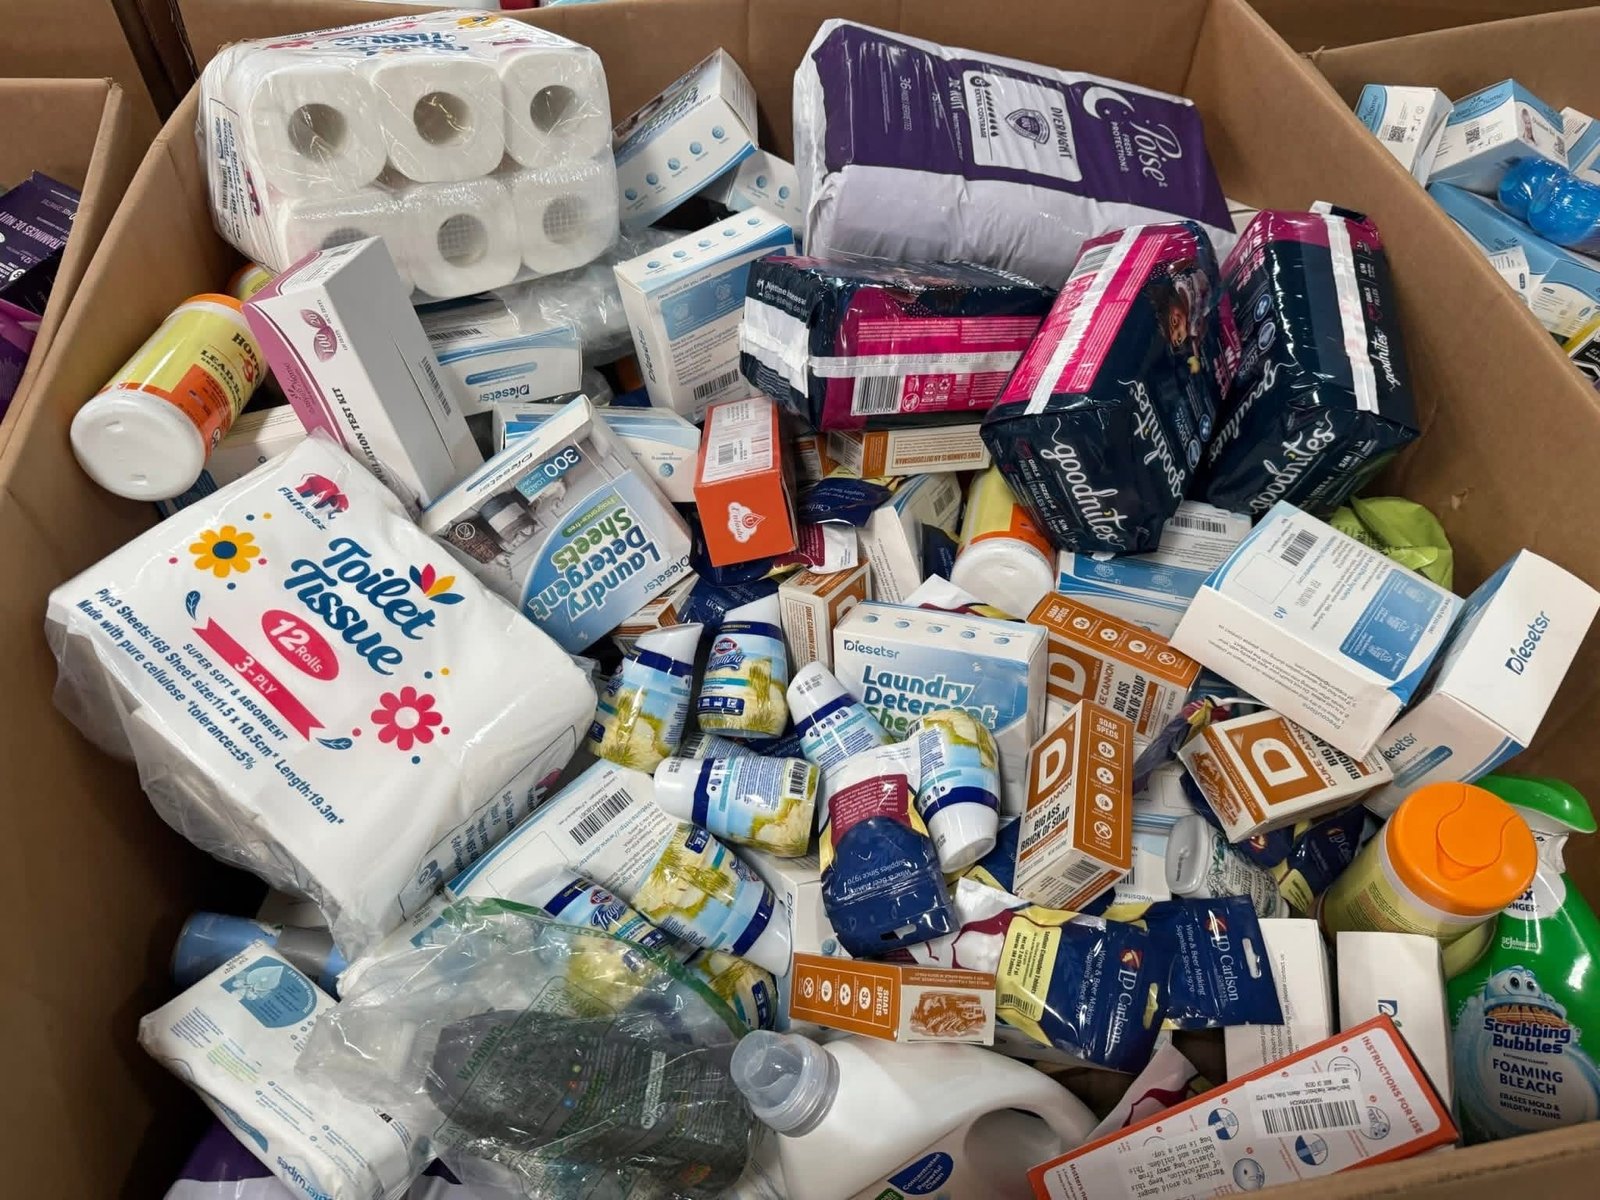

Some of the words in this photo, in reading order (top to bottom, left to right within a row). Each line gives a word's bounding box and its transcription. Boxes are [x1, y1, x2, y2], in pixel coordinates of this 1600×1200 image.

[1122, 133, 1133, 157] FRESH
[1130, 118, 1182, 178] Poise
[1370, 325, 1402, 393] goodnites
[332, 386, 350, 405] KIT
[479, 383, 530, 402] Diesetsr
[343, 405, 360, 431] TEST
[543, 448, 580, 479] 300
[1250, 410, 1337, 513] goodnites
[1027, 458, 1040, 477] GIRLS
[1057, 517, 1069, 532] S/M
[1040, 418, 1127, 550] goodnites
[552, 507, 632, 571] Sheets
[527, 524, 647, 620] Detergent
[566, 541, 661, 621] Laundry
[642, 555, 691, 594] Diesetsr
[322, 538, 436, 640] Toilet
[284, 559, 403, 676] Tissue
[76, 599, 103, 621] Made
[99, 620, 126, 643] with
[120, 640, 145, 662] pure
[142, 659, 187, 702] cellulose
[116, 606, 171, 654] Sheets:168
[165, 649, 197, 682] Sheet
[270, 618, 310, 651] 12
[295, 645, 323, 674] Rolls
[843, 639, 900, 661] Diesetsr
[1505, 610, 1552, 675] Diesetsr
[183, 643, 212, 671] SUPER
[209, 666, 234, 690] SOFT
[230, 686, 240, 696] &
[237, 693, 289, 742] ABSORBENT
[862, 665, 974, 705] Laundry
[1102, 662, 1115, 694] CANNON
[1117, 680, 1130, 700] ASS
[1134, 674, 1146, 696] SOAP
[1113, 698, 1125, 713] BIG
[1131, 691, 1141, 707] OF
[1096, 724, 1119, 740] SPECS
[1099, 717, 1118, 731] SOAP
[1320, 747, 1338, 766] BIG
[1382, 733, 1418, 763] iesetsr
[1037, 737, 1067, 795] D
[1313, 756, 1337, 787] DUKE
[1024, 806, 1043, 823] DUKE
[1043, 779, 1073, 808] CANNON
[1020, 832, 1042, 851] BRICK
[1041, 825, 1052, 840] OF
[1052, 806, 1070, 831] SOAP
[1033, 815, 1046, 832] BIG
[1046, 803, 1060, 822] ASS
[1174, 923, 1189, 954] Supplies
[1180, 954, 1192, 974] Since
[1190, 949, 1200, 966] Beer
[1079, 980, 1090, 1000] Since
[1090, 977, 1101, 996] Beer
[1184, 975, 1195, 992] 1970
[1192, 967, 1207, 996] Making
[1218, 952, 1243, 1001] Carlson
[875, 985, 883, 1016] SPECS
[1083, 996, 1098, 1025] Making
[1108, 991, 1134, 1045] Carlson
[1484, 1018, 1571, 1044] Scrubbing
[1493, 1034, 1563, 1054] Bubbles
[1361, 1034, 1402, 1099] INSTRUCTIONS
[1397, 1096, 1414, 1117] FOR
[1408, 1115, 1424, 1135] USE
[1493, 1058, 1563, 1083] FOAMING
[1500, 1073, 1557, 1095] BLEACH
[1500, 1092, 1527, 1106] ERASES
[1528, 1099, 1552, 1110] MOLD
[1500, 1101, 1531, 1113] MILDEW
[1532, 1108, 1561, 1120] STAINS
[1174, 1143, 1187, 1153] not
[1199, 1135, 1212, 1145] bag
[902, 1152, 942, 1192] Concentrated
[1172, 1160, 1186, 1170] bag
[1186, 1151, 1214, 1166] plastic
[1211, 1159, 1221, 1168] of
[1067, 1162, 1086, 1192] Matters
[1130, 1181, 1146, 1192] this
[1137, 1170, 1154, 1180] from
[1148, 1175, 1164, 1187] keep
[1194, 1166, 1224, 1182] Warning:
